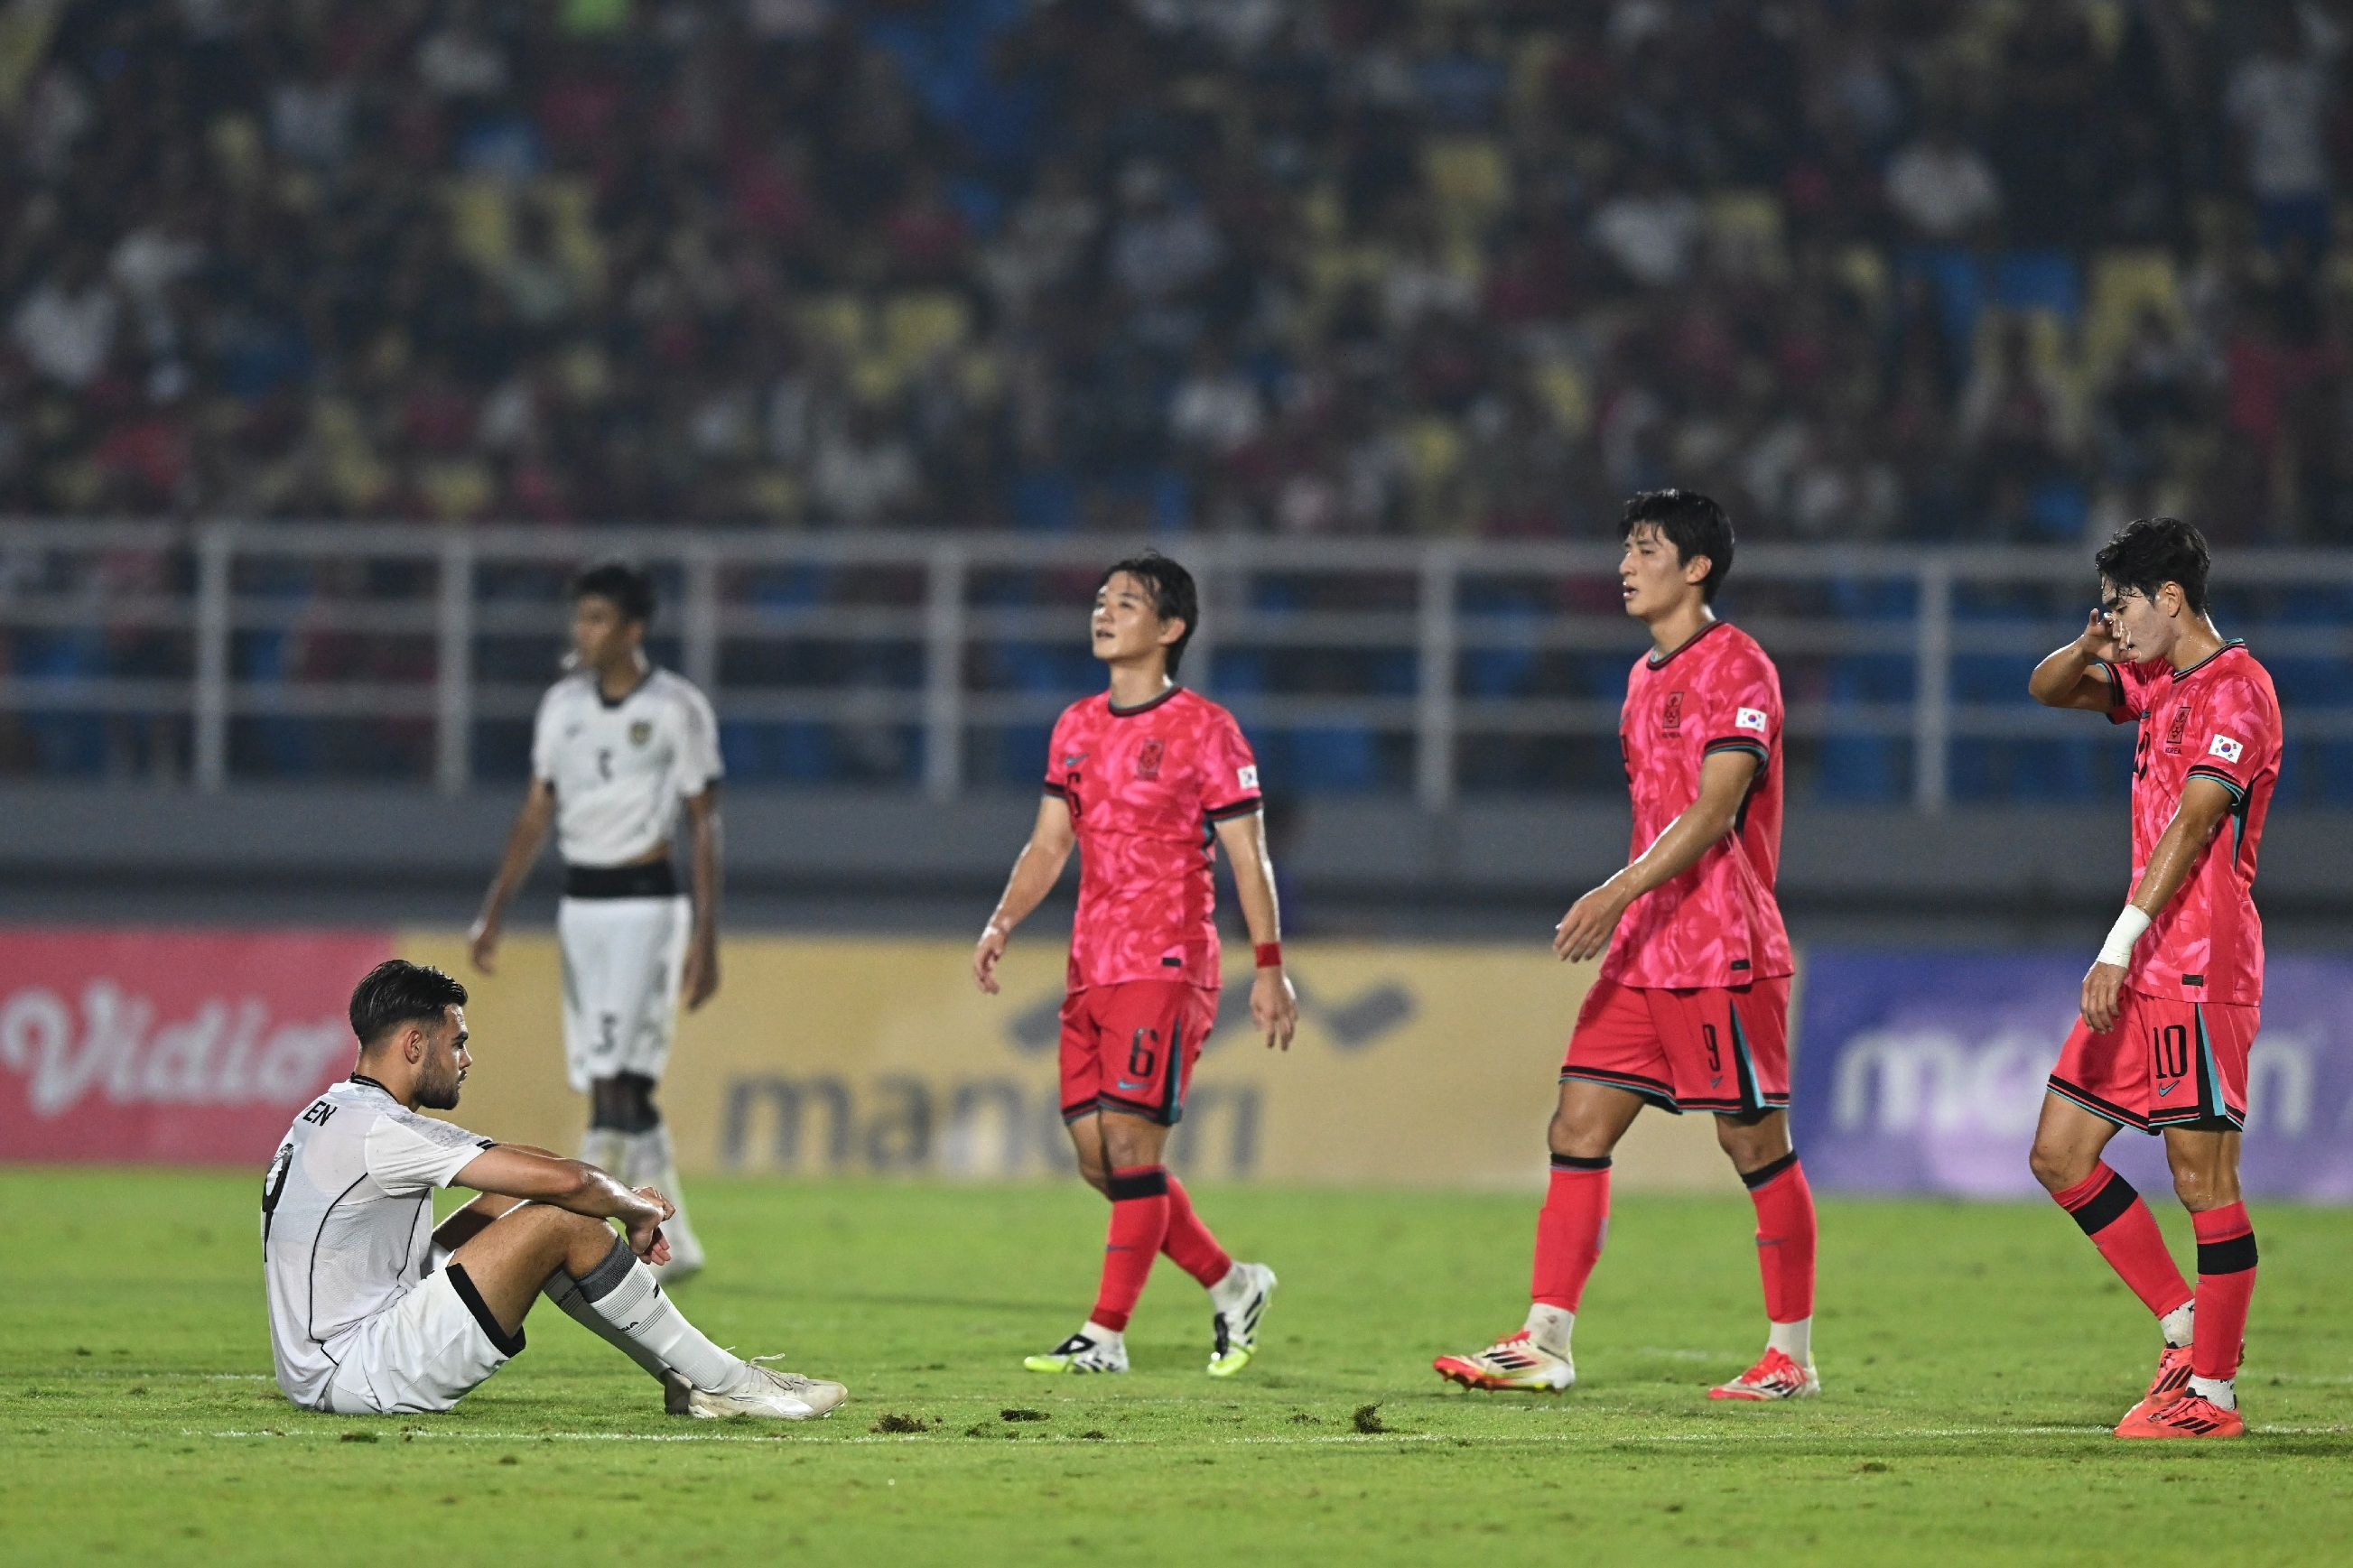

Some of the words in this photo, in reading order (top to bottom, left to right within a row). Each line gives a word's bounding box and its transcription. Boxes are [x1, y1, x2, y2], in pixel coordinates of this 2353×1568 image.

[1129, 1027, 1158, 1078] 6
[1702, 1023, 1721, 1072] 9
[2153, 1024, 2188, 1079] 10
